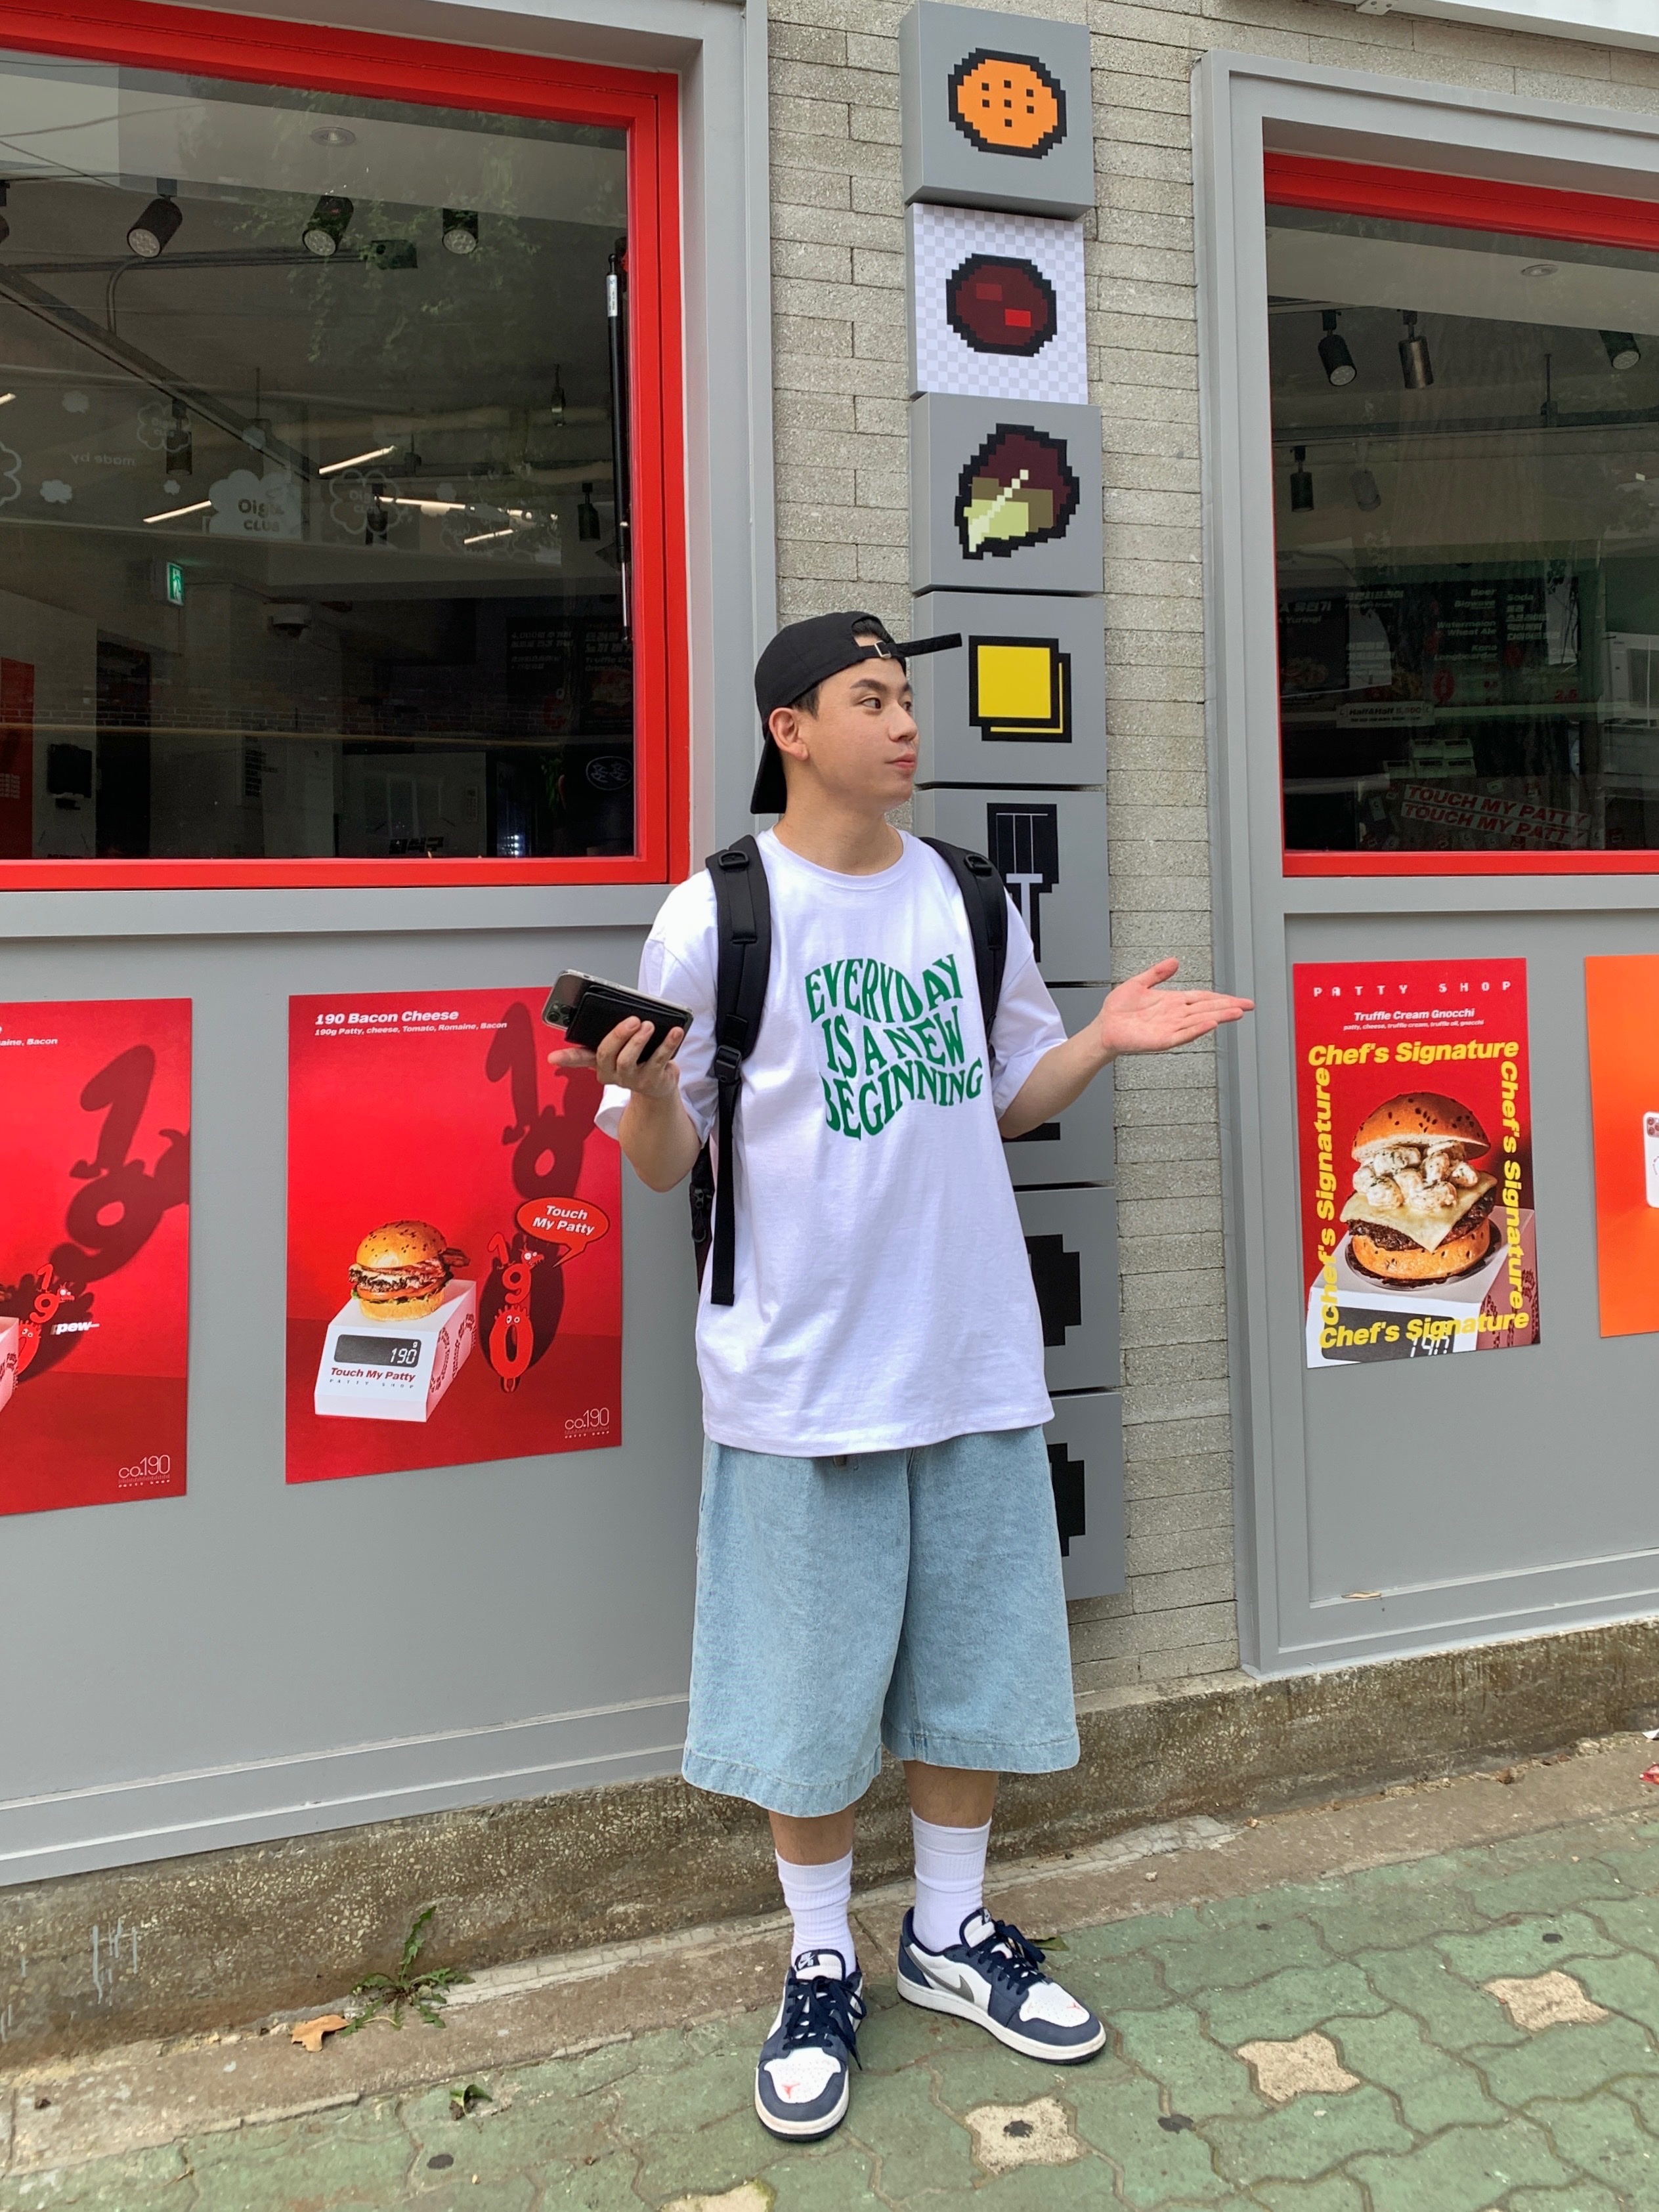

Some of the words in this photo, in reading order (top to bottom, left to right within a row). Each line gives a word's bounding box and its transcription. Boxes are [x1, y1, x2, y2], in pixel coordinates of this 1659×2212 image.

[1408, 786, 1476, 809] TOUCH
[1480, 798, 1519, 817] MY
[1519, 805, 1589, 827] PATTY
[1404, 802, 1473, 826] TOUCH
[1476, 815, 1515, 834] MY
[1515, 821, 1585, 845] PATTY
[805, 954, 964, 1023] EVERYDAY
[1314, 984, 1408, 997] PATTY
[1438, 981, 1511, 993] SHOP
[314, 1027, 337, 1036] 190g
[338, 1027, 365, 1036] Patty,
[366, 1025, 400, 1034] cheese,
[402, 1024, 438, 1033] Tomato,
[438, 1023, 479, 1032] Romaine,
[480, 1022, 507, 1031] Bacon
[315, 1013, 345, 1025] 190
[348, 1012, 399, 1025] Bacon
[402, 1010, 460, 1022] Cheese
[1354, 1011, 1392, 1022] Truffle
[1392, 1010, 1430, 1021] Cream
[1431, 1008, 1476, 1019] Gnocchi
[1362, 1022, 1387, 1031] cheese,
[821, 1013, 857, 1078] IS
[863, 1025, 887, 1076] A
[883, 1006, 965, 1067] NEW
[1308, 1042, 1390, 1067] Chef's
[1394, 1038, 1520, 1066] Signature
[819, 1057, 983, 1141] BEGINNING
[1501, 1061, 1520, 1154] Chef's
[1313, 1067, 1337, 1221] Signature
[532, 1216, 555, 1231] My
[556, 1220, 595, 1236] Patty
[546, 1204, 588, 1220] Touch
[1503, 1160, 1524, 1309] Signature
[1317, 1227, 1339, 1326] Chef's
[1319, 1321, 1400, 1349] Chef's
[1405, 1312, 1530, 1341] Signature
[390, 1348, 418, 1365] 190
[330, 1367, 364, 1378] Touch
[365, 1369, 383, 1380] My
[385, 1371, 417, 1383] Patty
